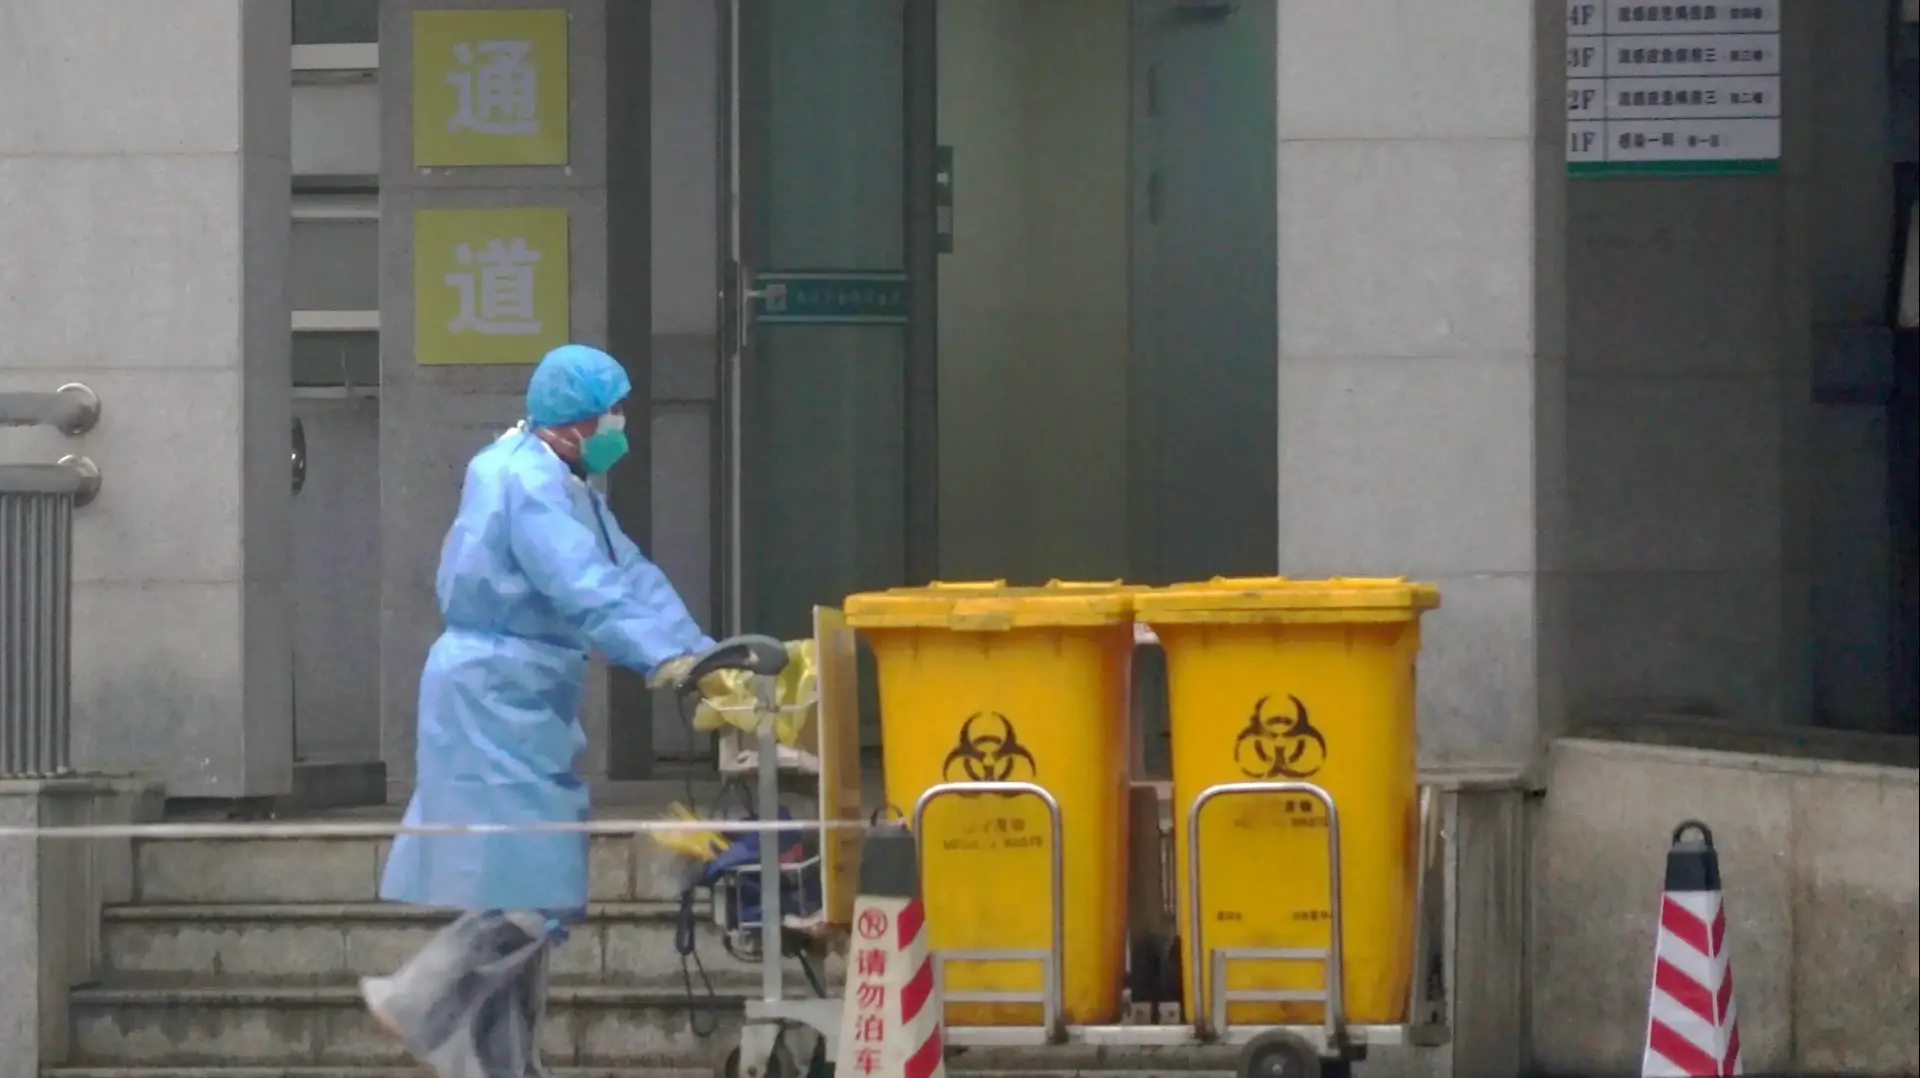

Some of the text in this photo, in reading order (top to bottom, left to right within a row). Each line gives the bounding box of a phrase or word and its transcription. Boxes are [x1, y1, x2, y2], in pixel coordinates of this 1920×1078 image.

[1568, 5, 1596, 25] 4F
[1568, 47, 1595, 67] 3F
[446, 40, 540, 134] 通
[1567, 89, 1596, 110] 2F
[1570, 132, 1596, 152] 1F
[445, 238, 542, 333] 道
[855, 949, 885, 1076] 请勿泊车
